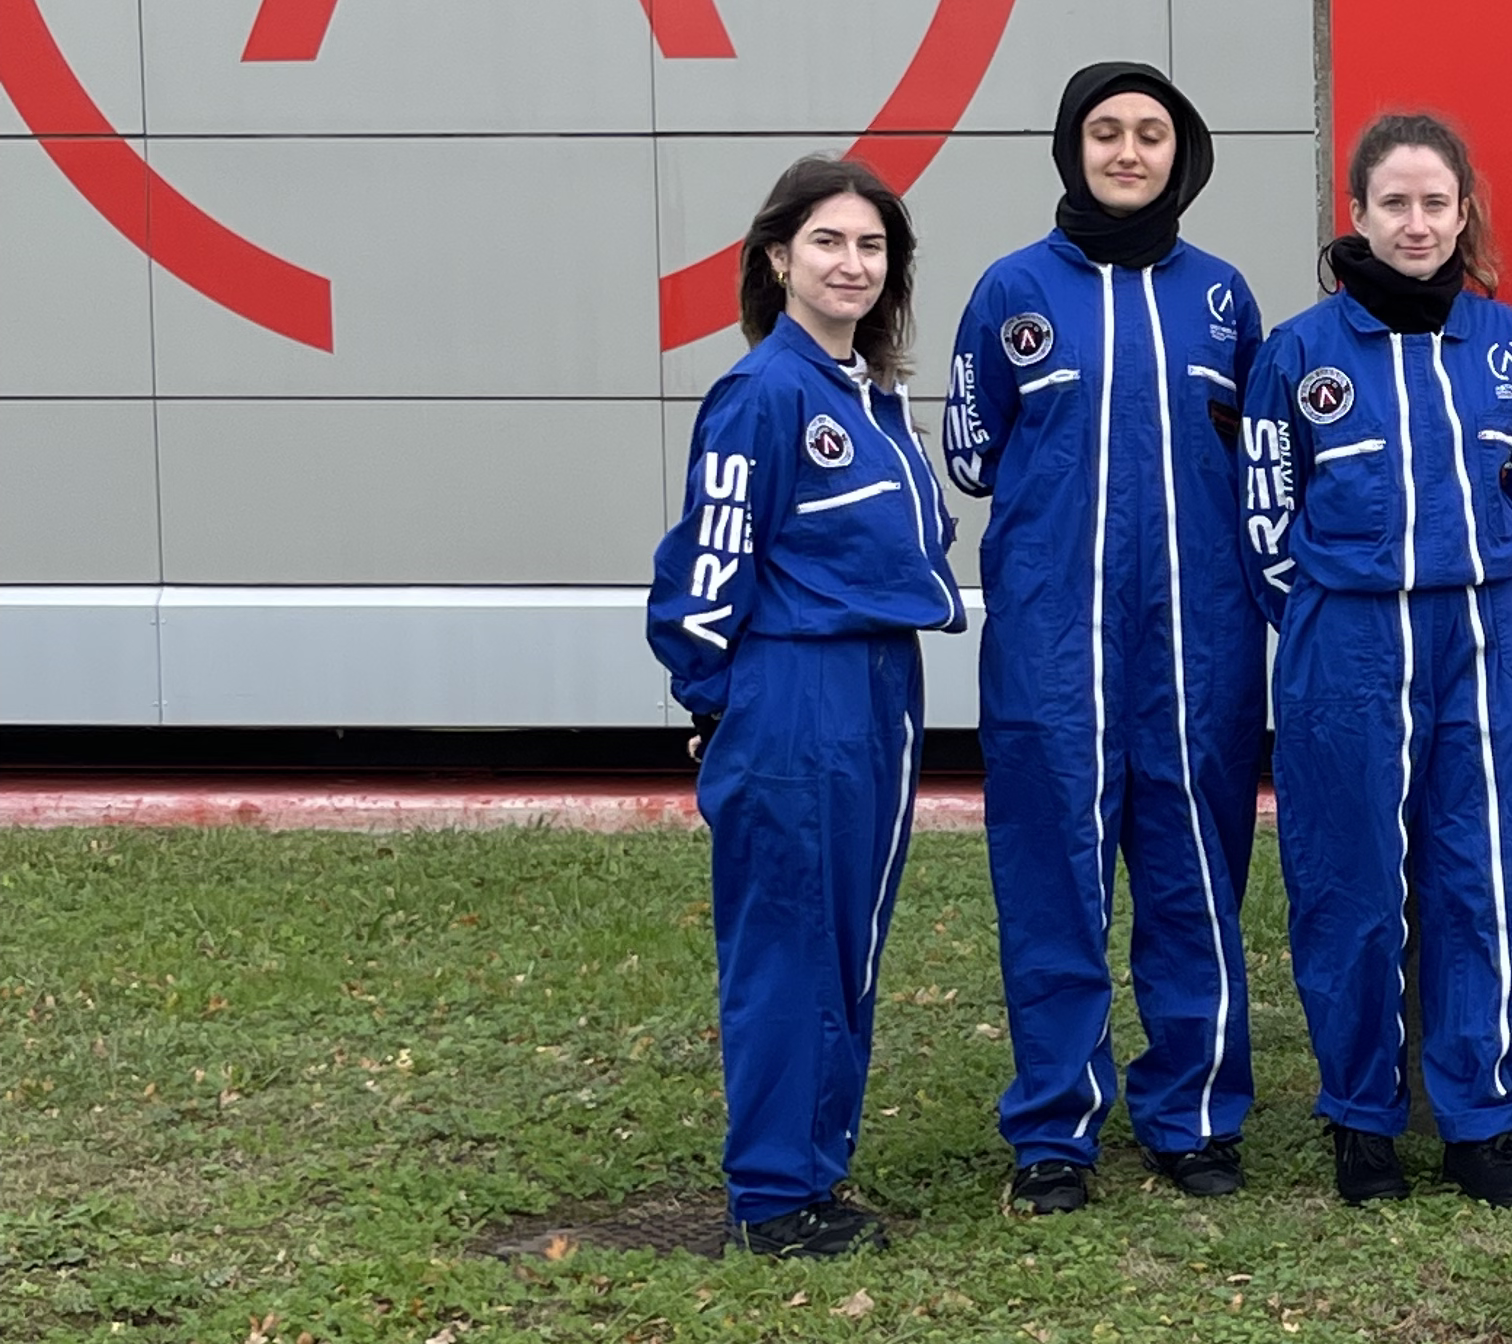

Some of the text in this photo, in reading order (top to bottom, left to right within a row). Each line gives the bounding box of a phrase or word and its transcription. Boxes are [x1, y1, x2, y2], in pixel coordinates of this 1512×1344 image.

[946, 354, 987, 490] RES
[964, 353, 991, 444] STATION
[1277, 419, 1295, 511] STATION
[683, 451, 749, 650] ARES
[1242, 416, 1297, 594] ARES
